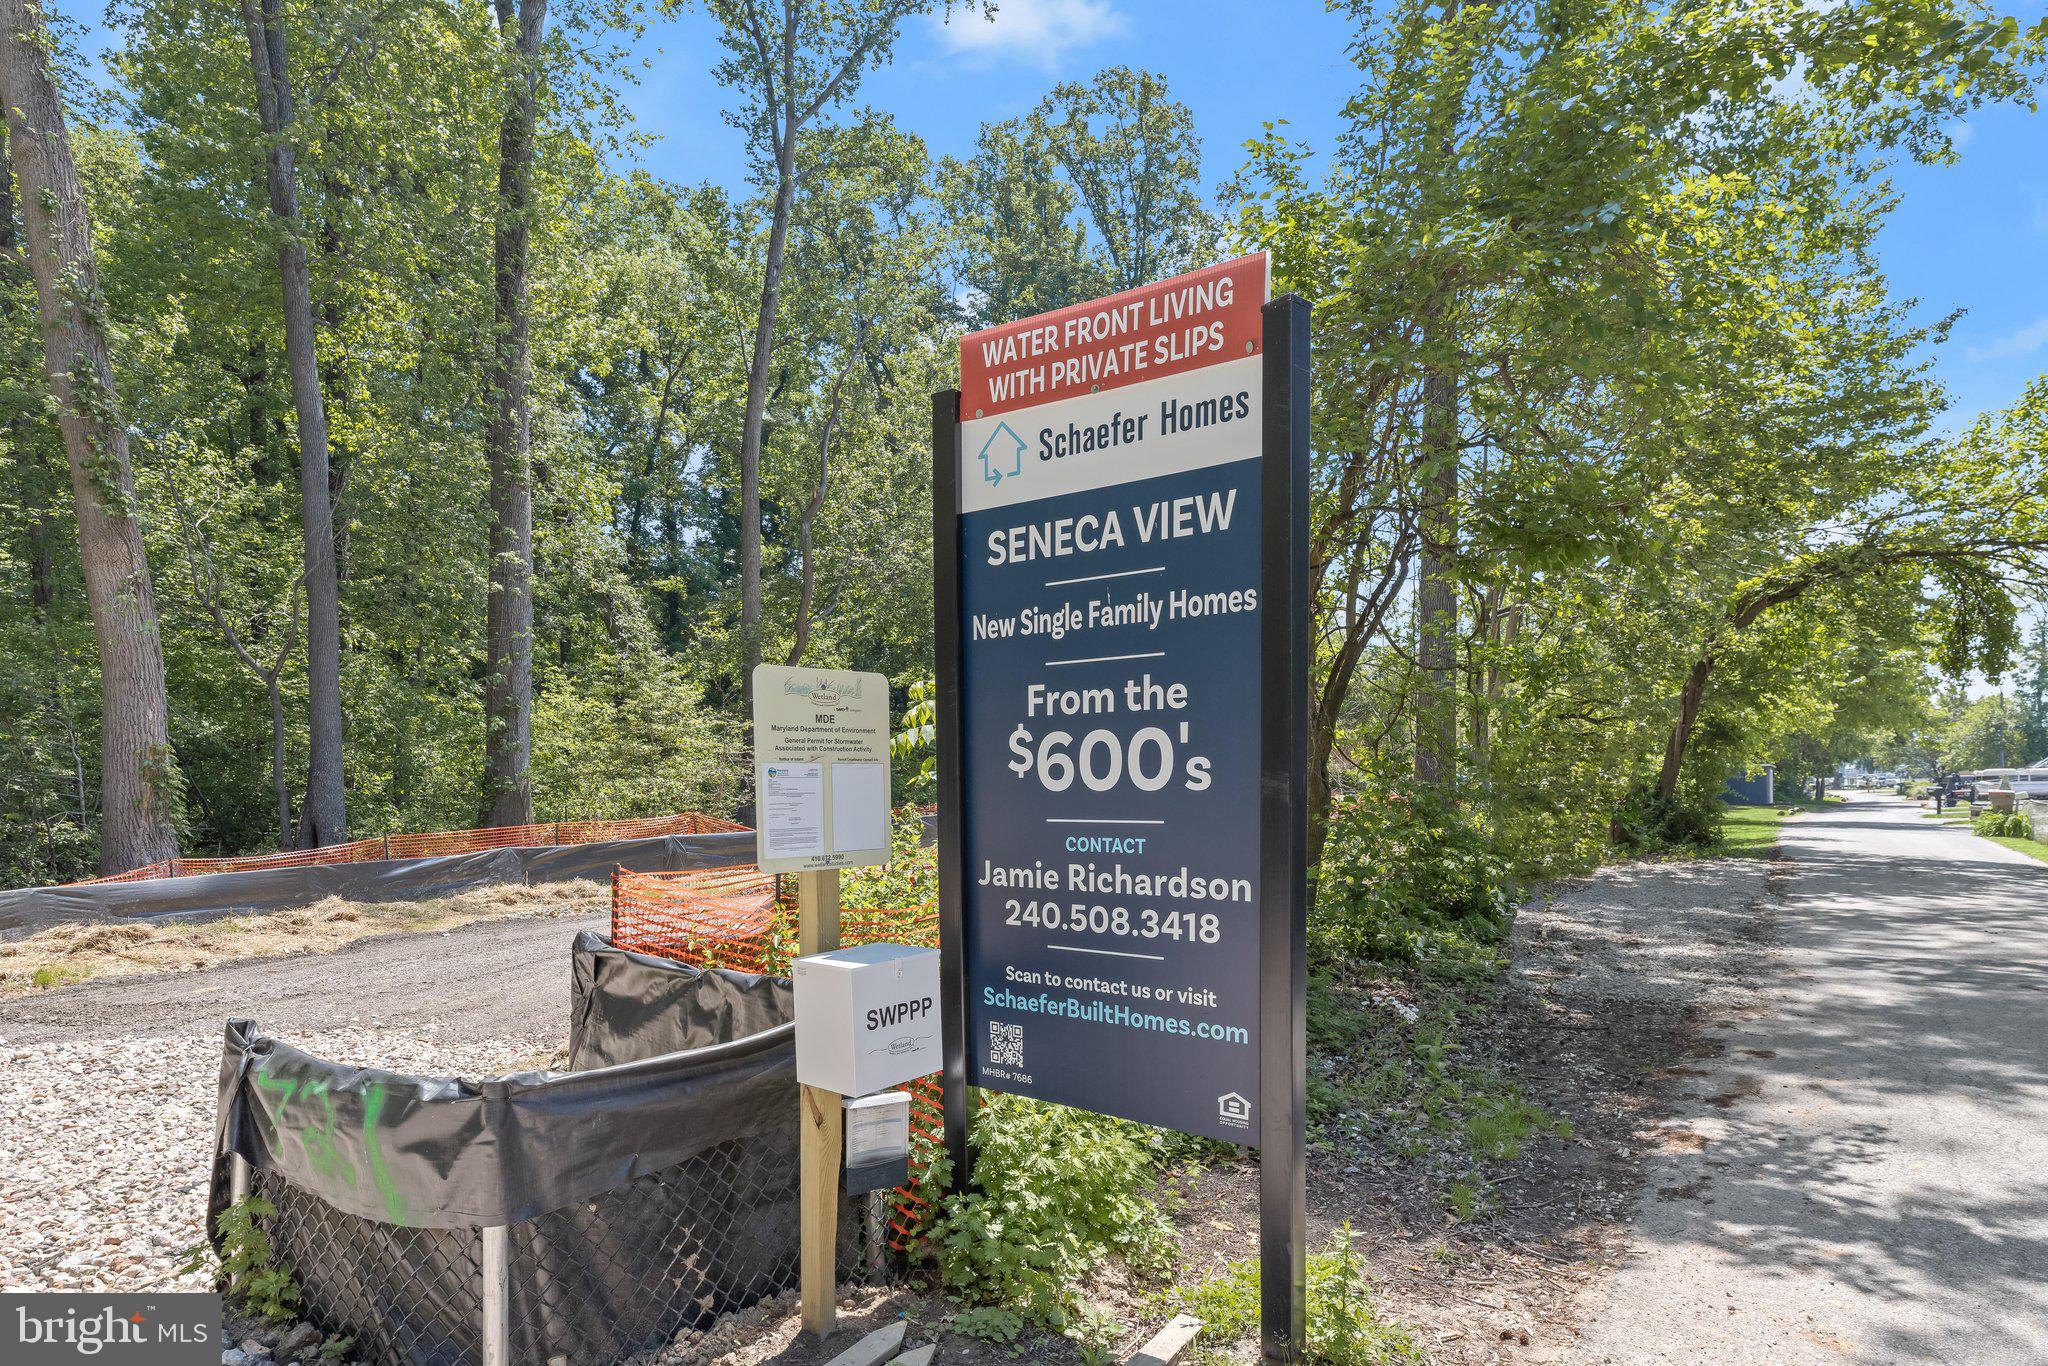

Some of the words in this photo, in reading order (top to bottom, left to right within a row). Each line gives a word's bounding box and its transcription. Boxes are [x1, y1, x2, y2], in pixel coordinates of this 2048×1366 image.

[982, 325, 1058, 367] WATER
[1065, 302, 1144, 349] FRONT
[1150, 277, 1234, 327] LIVING
[989, 365, 1045, 403] WITH
[1051, 341, 1148, 390] PRIVATE
[1154, 321, 1225, 365] SLIPS
[1039, 412, 1148, 461] Schaefer
[1161, 391, 1249, 435] Homes
[987, 510, 1125, 566] SENECA
[1133, 489, 1237, 543] VIEW
[972, 615, 1015, 640] New
[1020, 602, 1083, 640] Single
[1088, 592, 1163, 629] Family
[1169, 588, 1258, 619] Homes
[811, 692, 837, 700] Wetland
[1027, 684, 1115, 717] From
[1124, 674, 1188, 711] the
[771, 725, 799, 733] Maryland
[800, 726, 833, 734] Department
[815, 714, 835, 724] MDE
[1007, 721, 1212, 792] $600's
[1065, 836, 1146, 854] CONTACT
[978, 860, 1059, 890] Jamie
[1068, 863, 1252, 902] Richardson
[1005, 899, 1221, 944] 240.508.3418
[1005, 965, 1041, 984] Scan
[1045, 971, 1061, 987] to
[1064, 974, 1127, 996] contact
[1131, 984, 1150, 998] us
[1155, 987, 1173, 1002] or
[1177, 986, 1217, 1008] visit
[866, 997, 932, 1031] SWPPP
[983, 986, 1249, 1044] SchaeferBuiltHomes.com
[982, 1066, 1011, 1079] MHBR#
[1012, 1072, 1033, 1084] 7686
